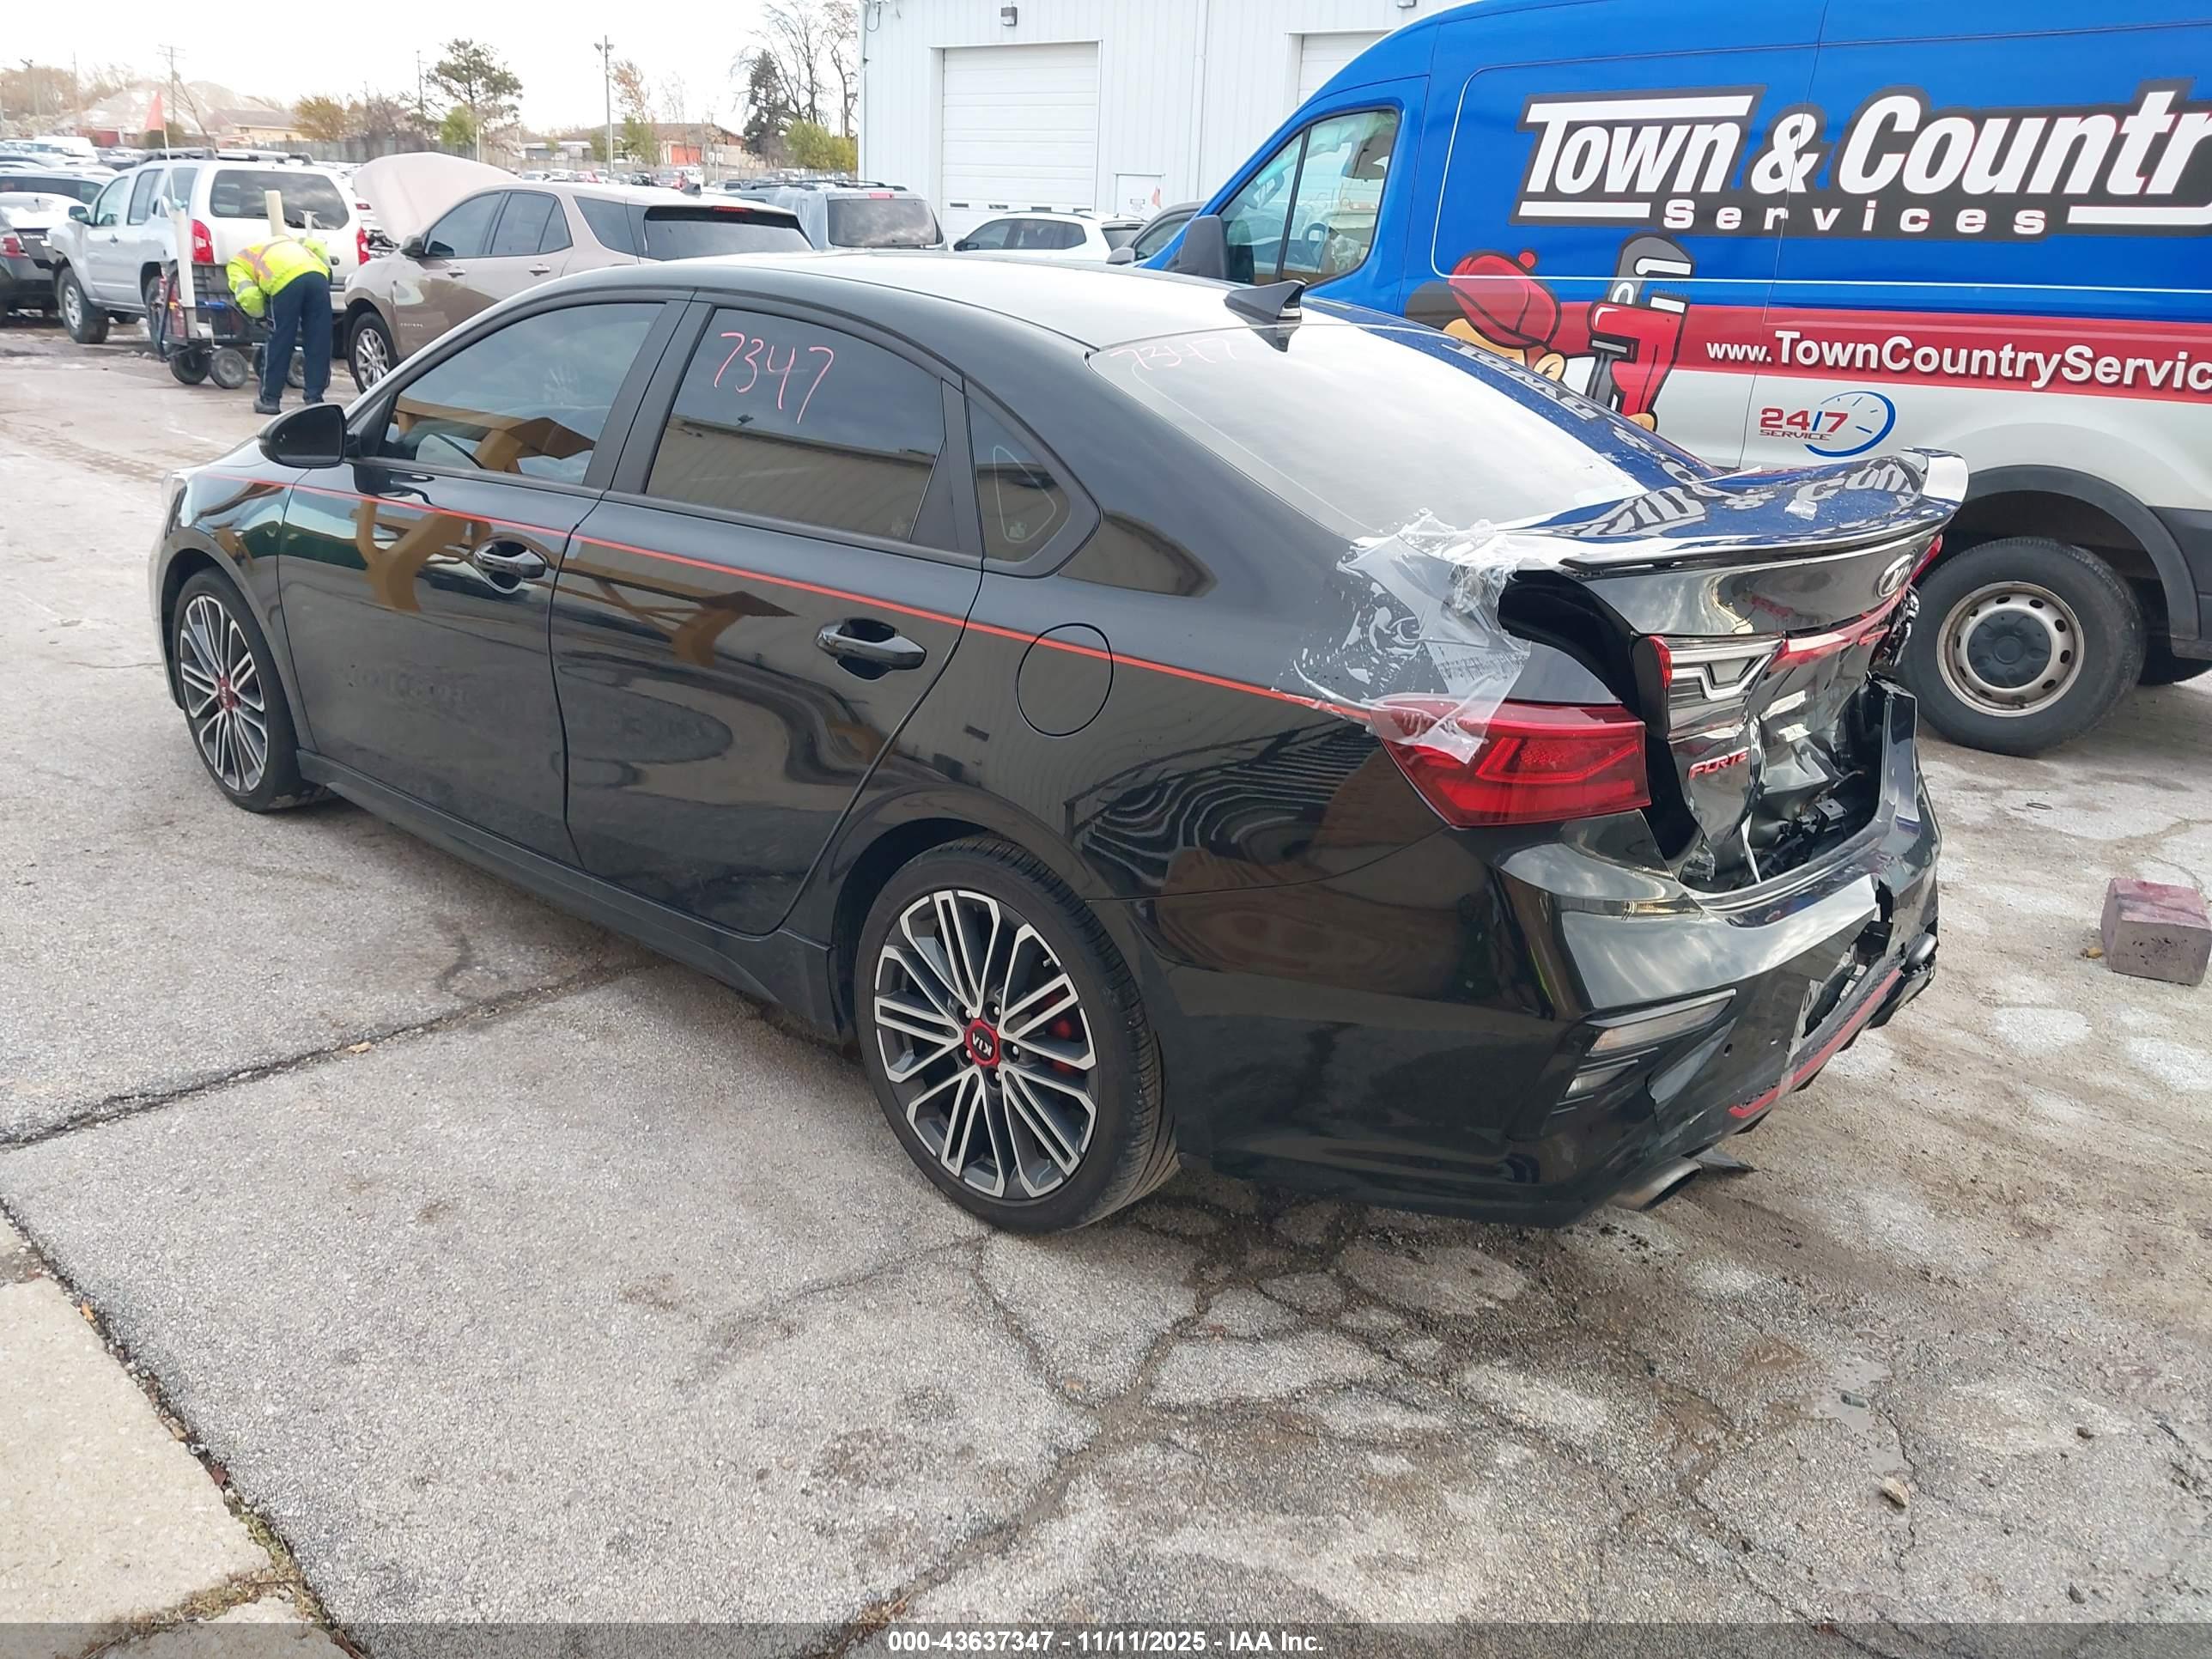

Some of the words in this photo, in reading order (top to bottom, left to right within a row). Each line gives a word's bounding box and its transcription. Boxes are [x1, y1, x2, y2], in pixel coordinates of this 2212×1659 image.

[1750, 112, 1823, 193] &
[1662, 198, 2047, 237] Services
[713, 331, 836, 424] 7347
[1759, 429, 1832, 441] SERVICE
[1690, 746, 1750, 780] FORTE
